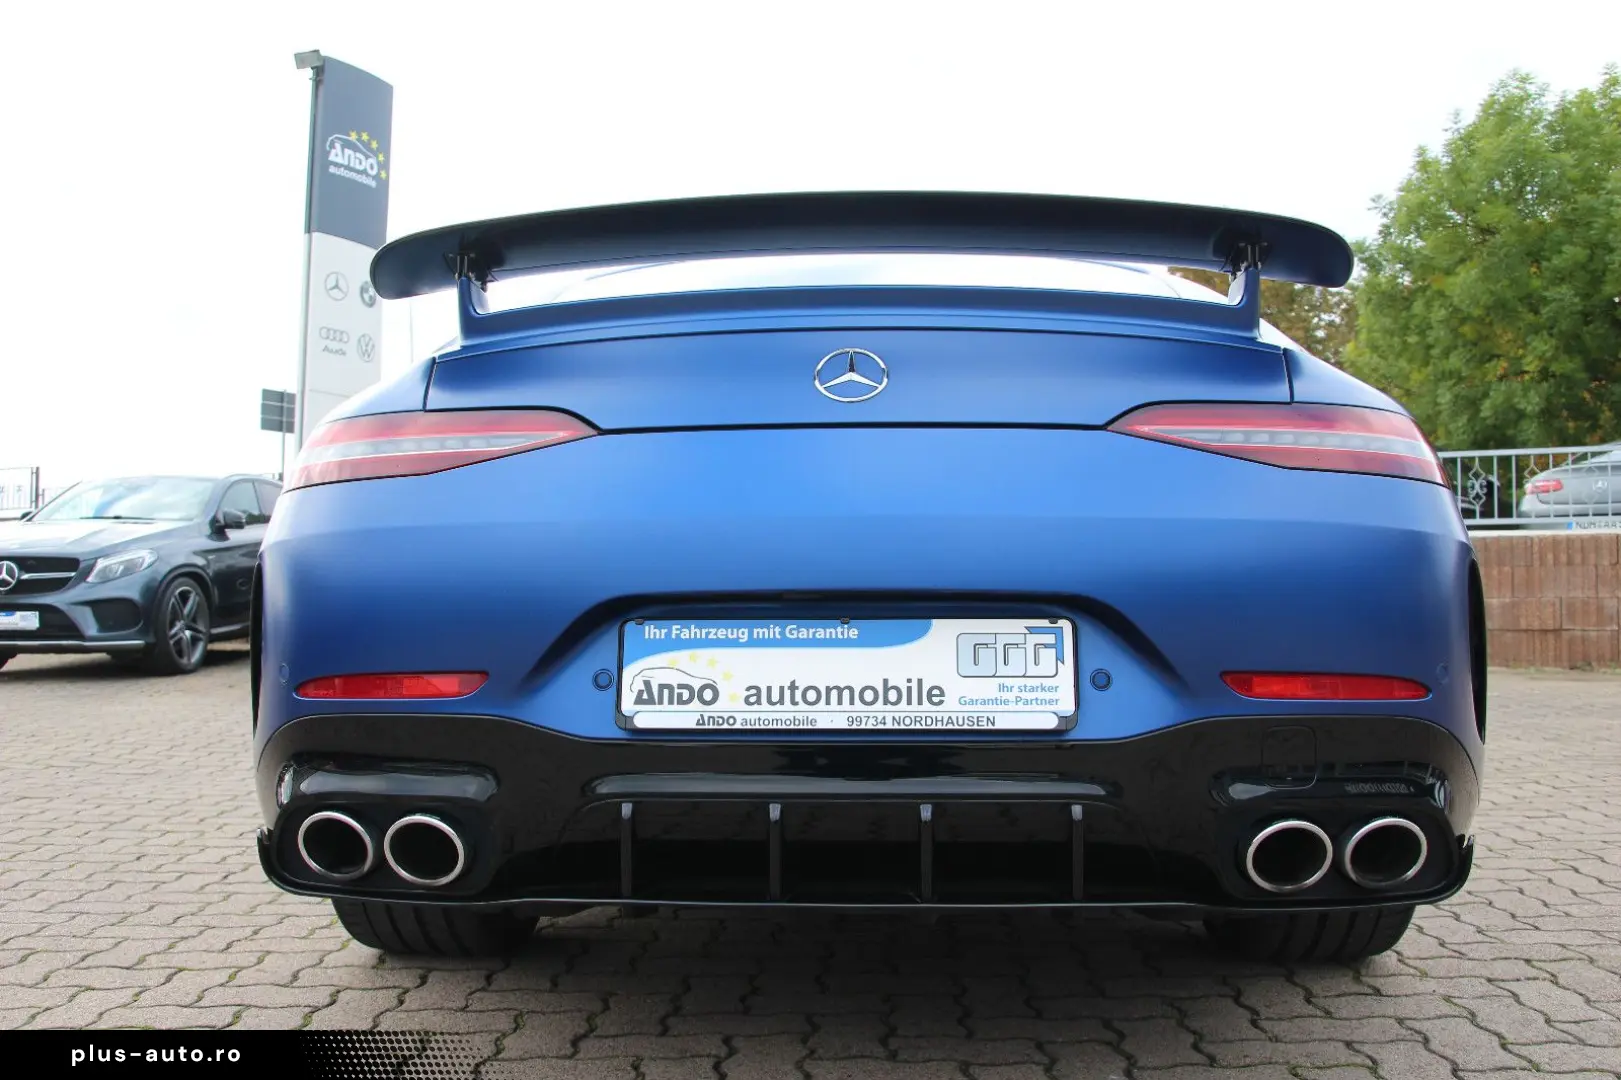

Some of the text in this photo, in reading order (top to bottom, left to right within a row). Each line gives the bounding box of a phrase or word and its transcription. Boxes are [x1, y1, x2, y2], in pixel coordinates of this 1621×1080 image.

[328, 165, 377, 188] automobile
[644, 624, 859, 642] Ihr Fahrzeug mit Garantie
[743, 678, 946, 706] automobile
[998, 683, 1060, 693] Ihr starker
[958, 696, 1060, 706] Garantie-Partner
[740, 715, 817, 727] automobile
[846, 715, 887, 727] 99734
[891, 715, 996, 727] NORDHAUSEN
